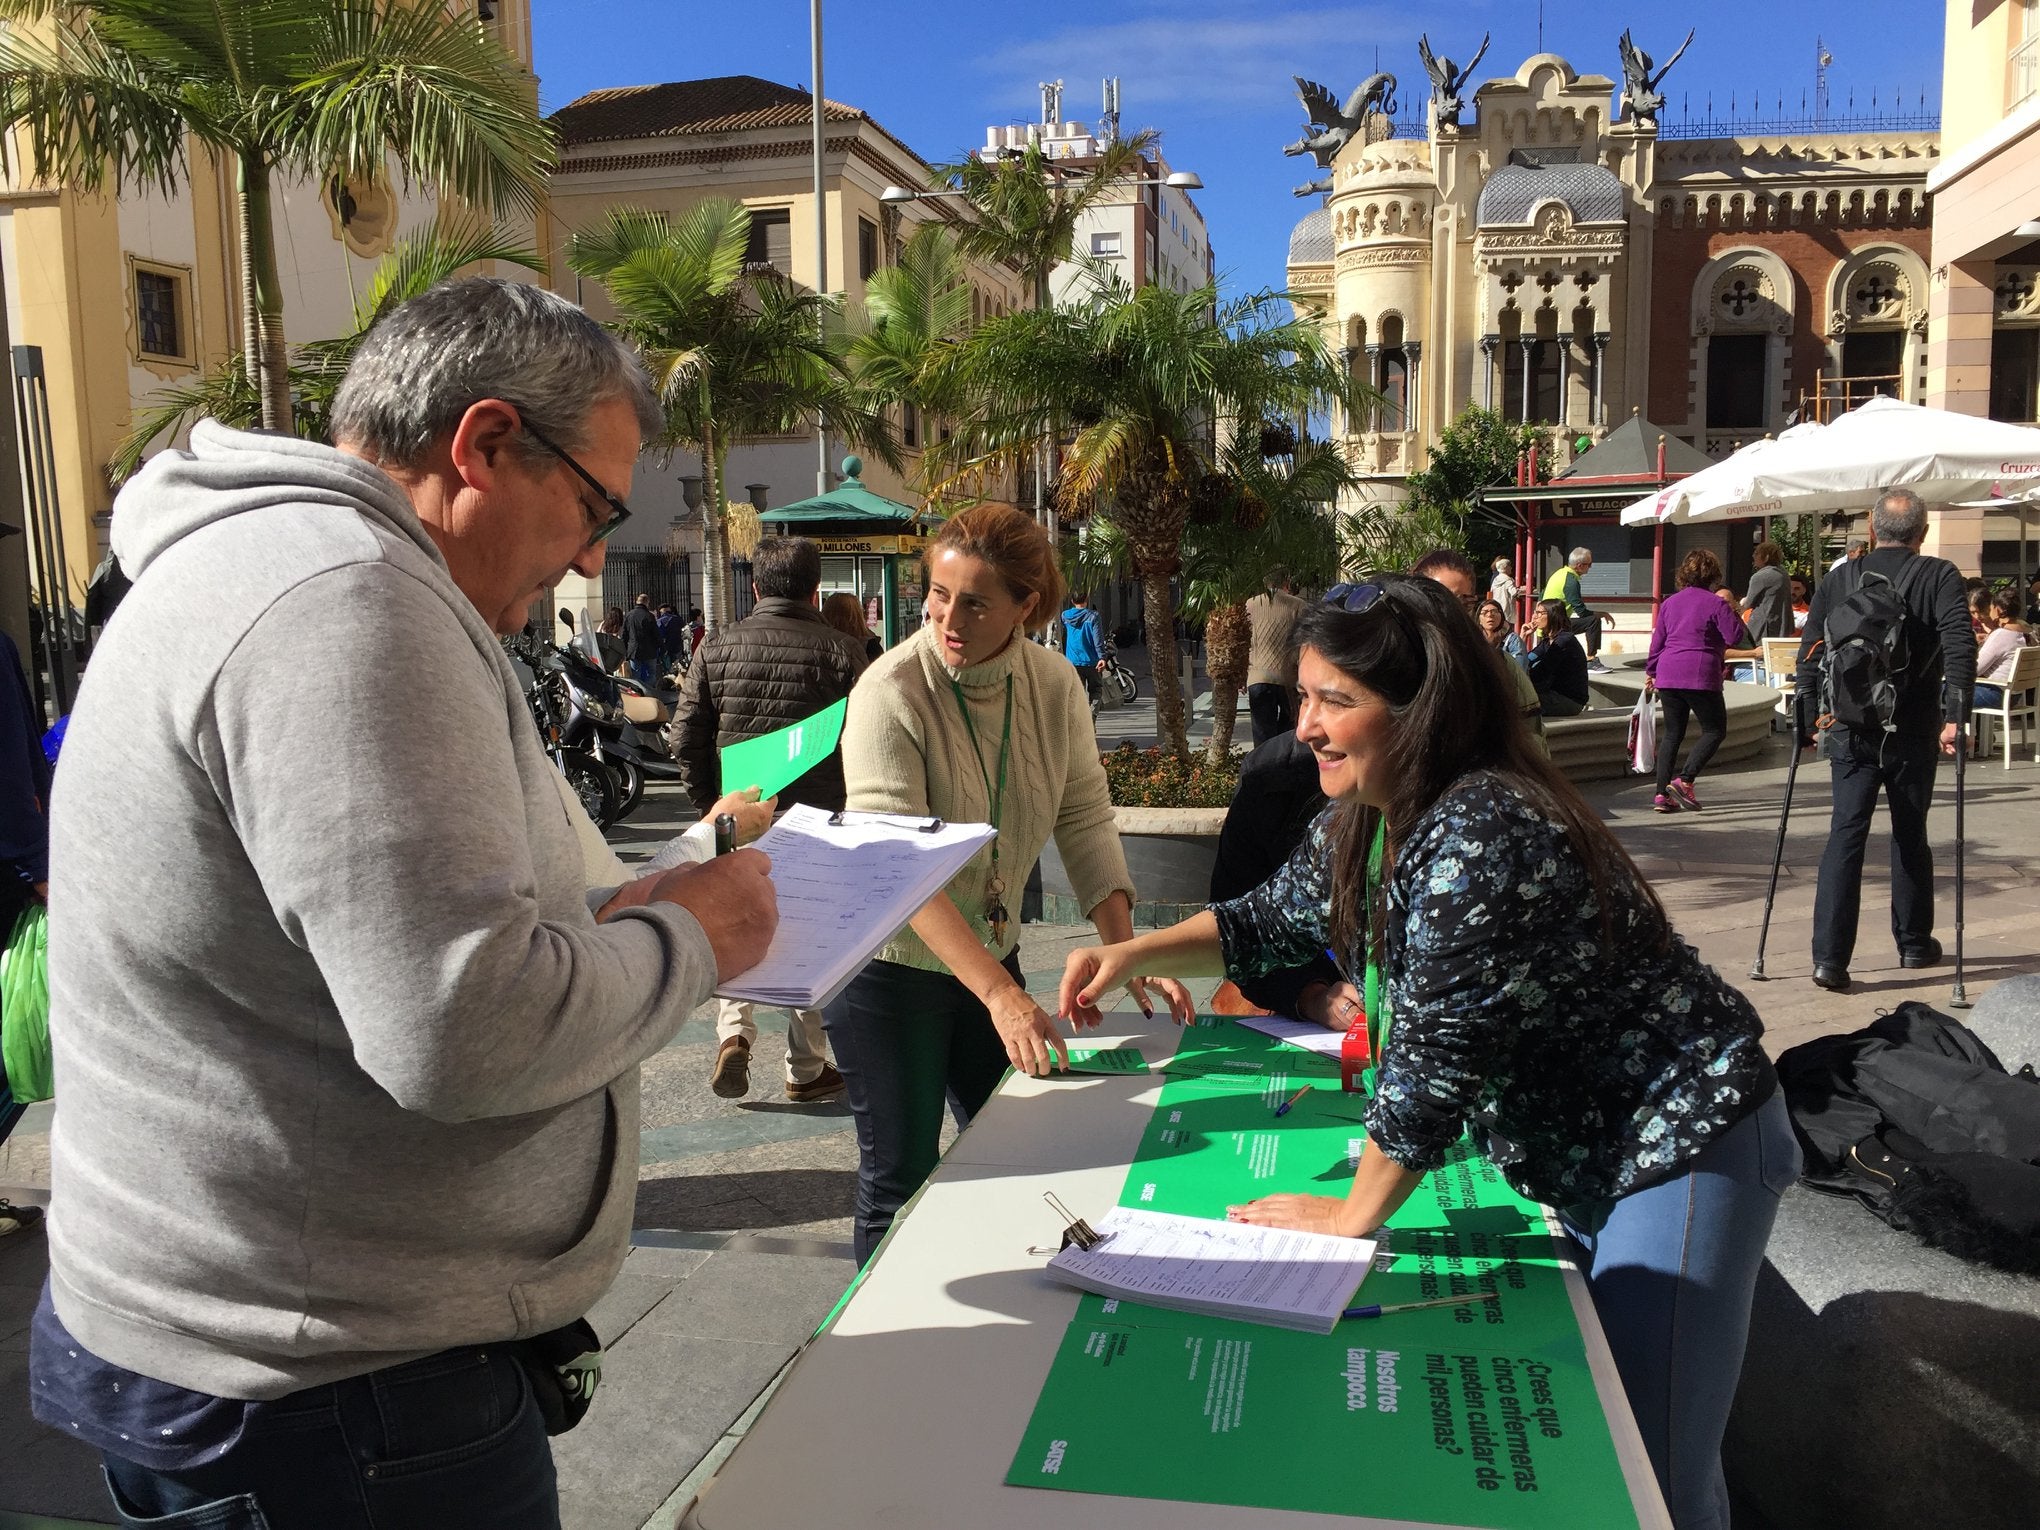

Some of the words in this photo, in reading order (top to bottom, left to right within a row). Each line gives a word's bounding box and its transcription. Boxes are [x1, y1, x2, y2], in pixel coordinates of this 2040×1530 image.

[823, 543, 872, 552] MILLONES
[1456, 1163, 1479, 1209] enfermeras
[1476, 1168, 1498, 1184] que
[1436, 1195, 1458, 1208] de
[1500, 1266, 1526, 1290] que
[1453, 1308, 1479, 1324] de
[1376, 1350, 1401, 1413] Nosotros
[1425, 1353, 1453, 1375] mil
[1491, 1356, 1519, 1394] cinco
[1517, 1358, 1555, 1405] ¿Crees
[1450, 1355, 1490, 1409] pueden
[1420, 1376, 1464, 1455] personas?
[1530, 1407, 1563, 1439] que
[1467, 1411, 1500, 1465] cuidar
[1499, 1396, 1538, 1492] enfermeras
[1475, 1466, 1506, 1491] de
